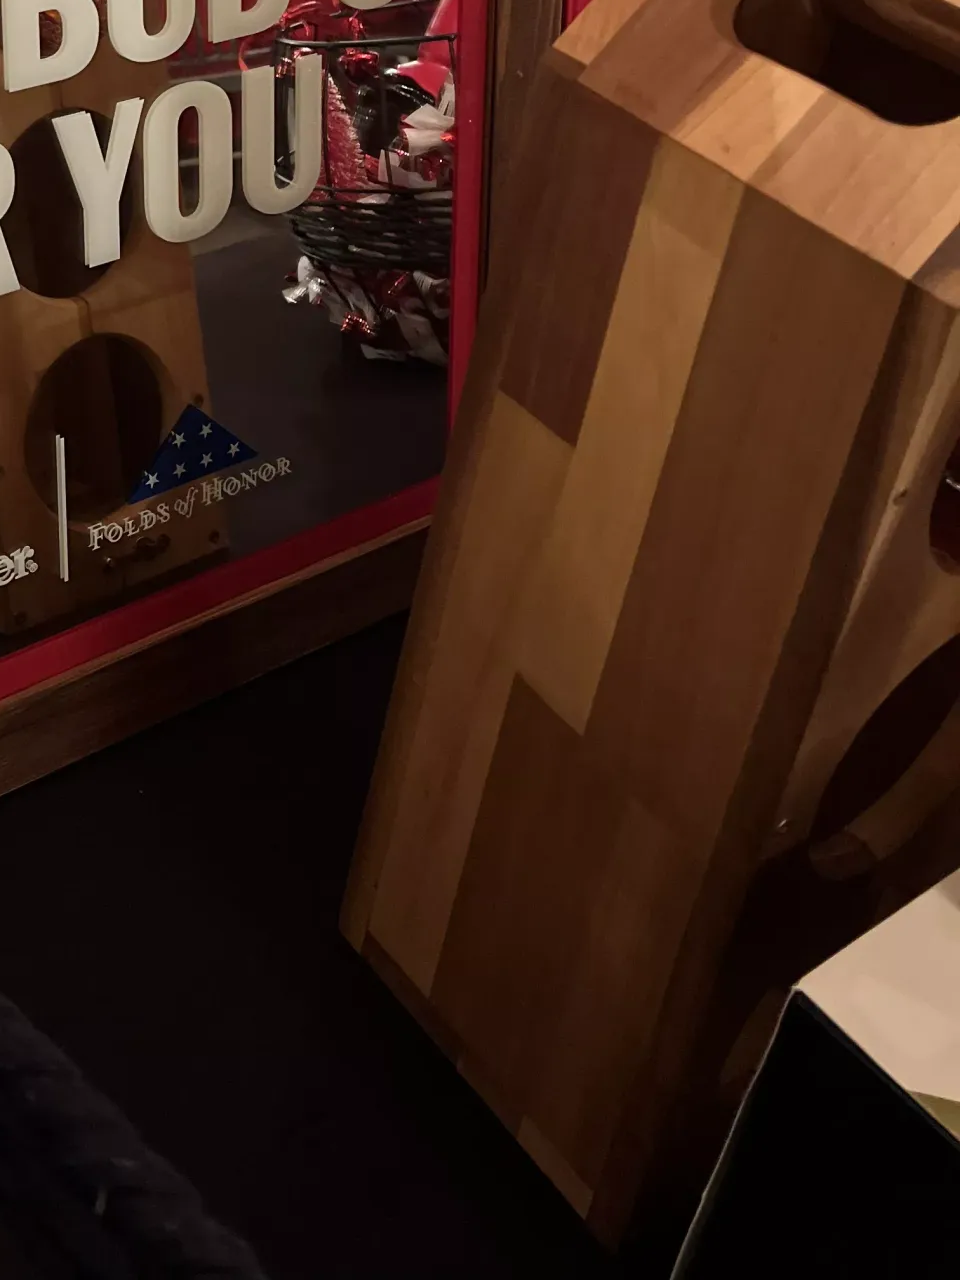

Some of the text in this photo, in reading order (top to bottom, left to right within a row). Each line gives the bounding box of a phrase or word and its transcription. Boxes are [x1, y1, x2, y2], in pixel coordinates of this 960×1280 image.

[52, 53, 324, 269] YOU
[86, 456, 293, 551] FOLDS of HONOR
